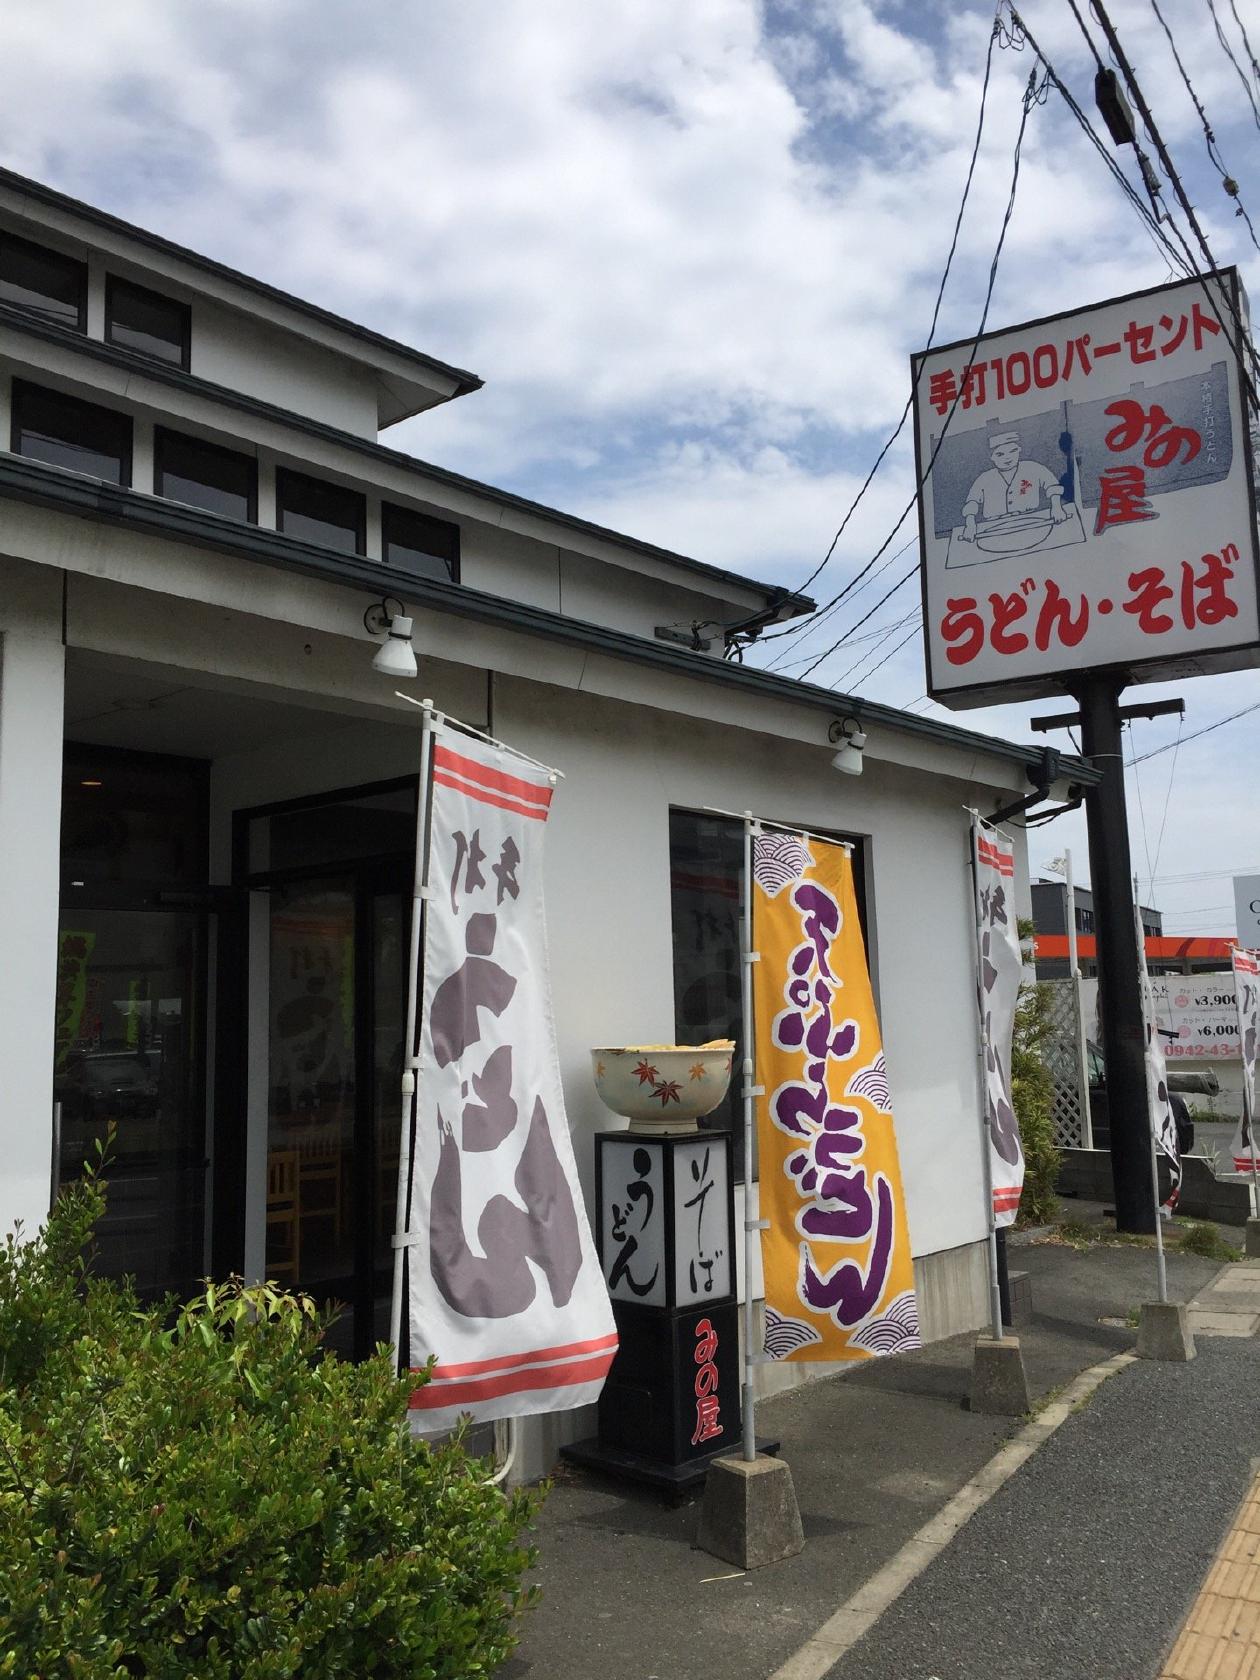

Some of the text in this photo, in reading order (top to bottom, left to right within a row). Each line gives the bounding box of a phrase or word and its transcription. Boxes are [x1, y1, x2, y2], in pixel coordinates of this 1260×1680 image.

[929, 303, 1221, 416] 手打100パーセント
[1095, 399, 1202, 536] みの屋
[608, 1147, 659, 1297] うどん
[683, 1146, 724, 1294] そば
[691, 1317, 724, 1446] みの屋
